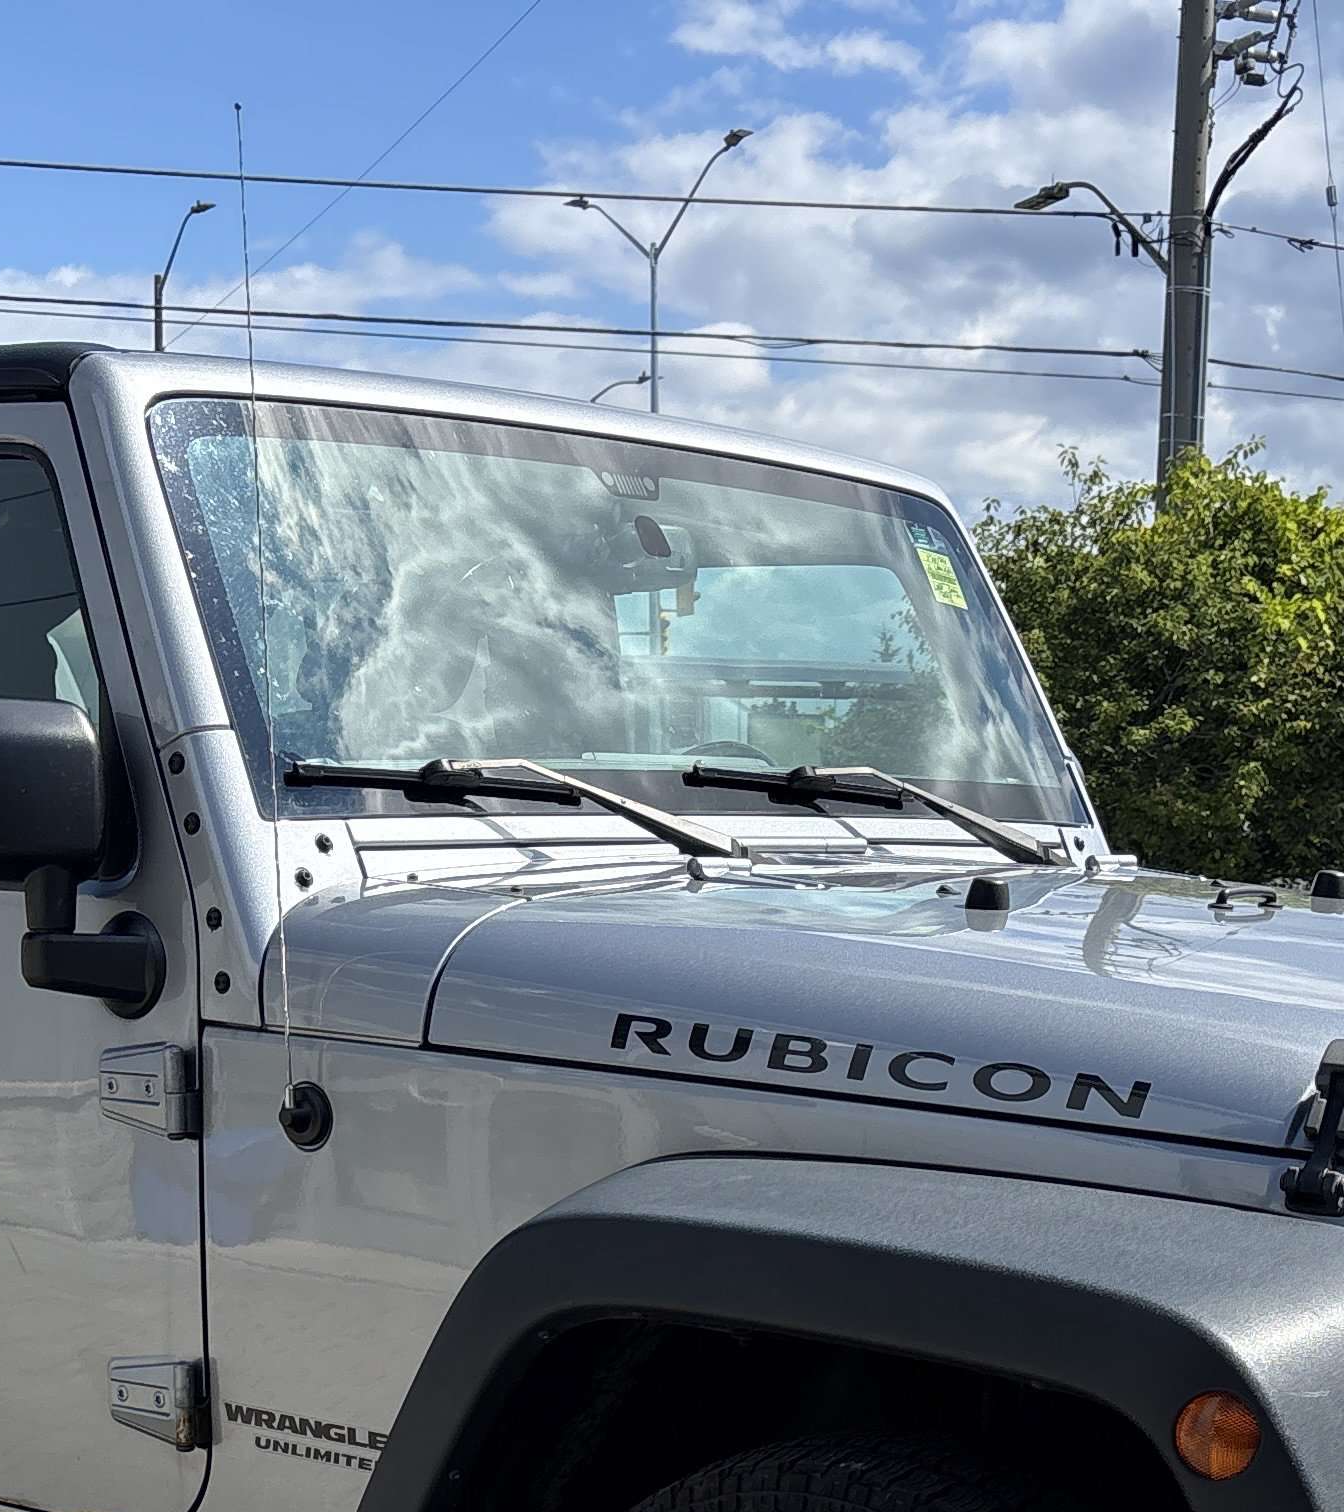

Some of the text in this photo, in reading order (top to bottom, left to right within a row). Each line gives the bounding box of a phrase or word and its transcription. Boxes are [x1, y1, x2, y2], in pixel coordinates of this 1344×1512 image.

[610, 1013, 1151, 1118] RUBICON
[224, 1402, 389, 1449] WRANGLE
[255, 1436, 373, 1471] UNLIMITE
